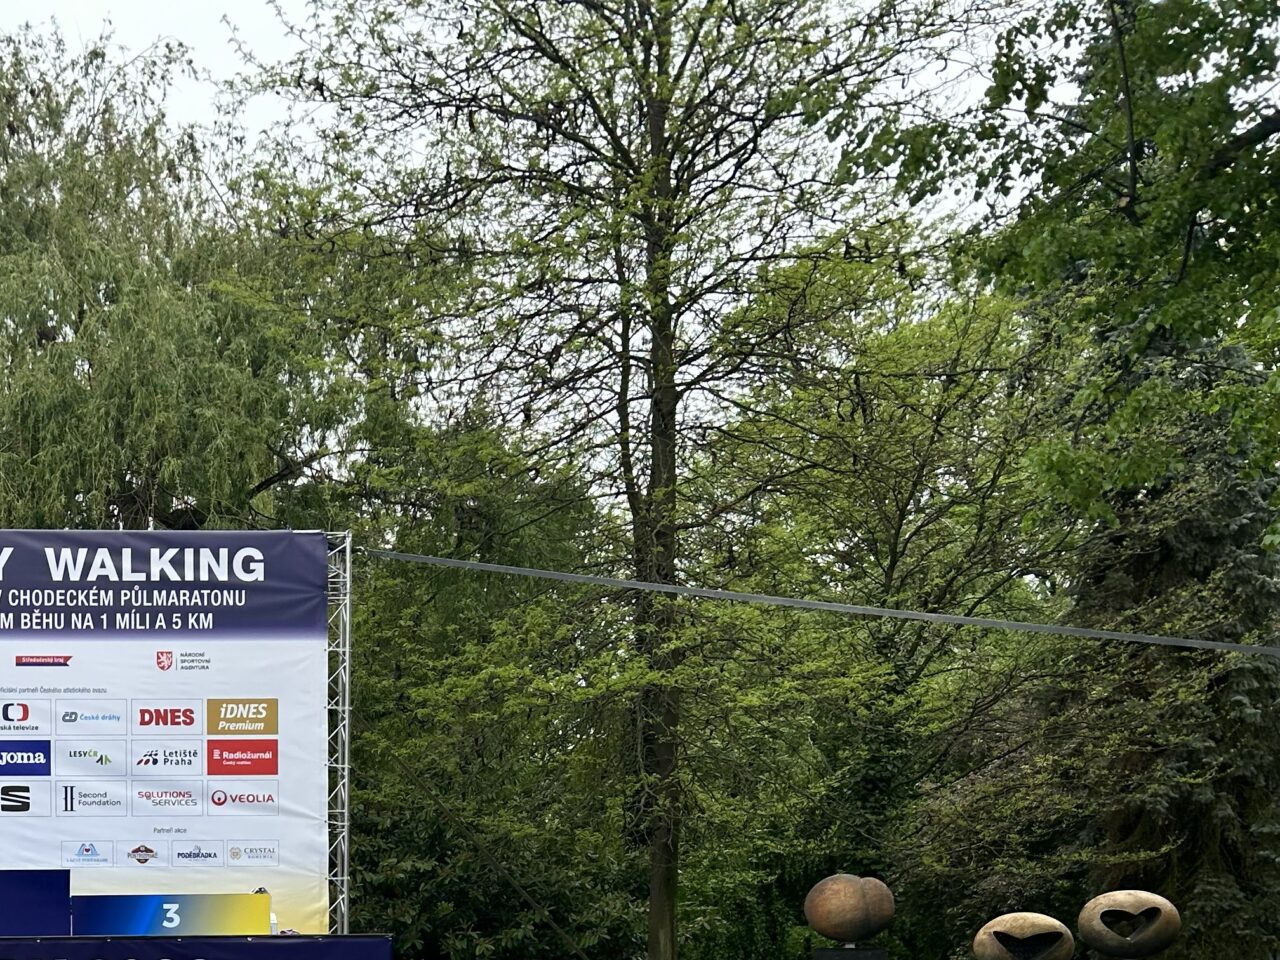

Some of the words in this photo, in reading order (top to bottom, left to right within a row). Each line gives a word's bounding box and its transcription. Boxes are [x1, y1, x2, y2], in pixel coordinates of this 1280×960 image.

[44, 547, 266, 582] WALKING
[8, 585, 114, 607] CHODECKÉM
[120, 585, 247, 607] PŮLMARATONU
[20, 608, 65, 630] BĚHU
[71, 612, 95, 630] NA
[100, 613, 108, 630] 1
[115, 608, 151, 630] MÍLI
[155, 613, 167, 630] A
[171, 613, 183, 630] 5
[188, 613, 214, 630] KM
[219, 703, 267, 719] iDNES
[79, 713, 100, 722] České
[100, 713, 121, 723] dráhy
[139, 708, 195, 726] DNES
[218, 720, 265, 731] Premium
[163, 750, 198, 758] Letiště
[222, 750, 273, 760] Radiožurnál
[163, 758, 193, 766] Praha
[78, 791, 108, 799] Second
[229, 793, 275, 803] VEOLIA
[78, 799, 122, 807] Foundation
[151, 799, 198, 807] SERVICES
[161, 903, 181, 929] 3
